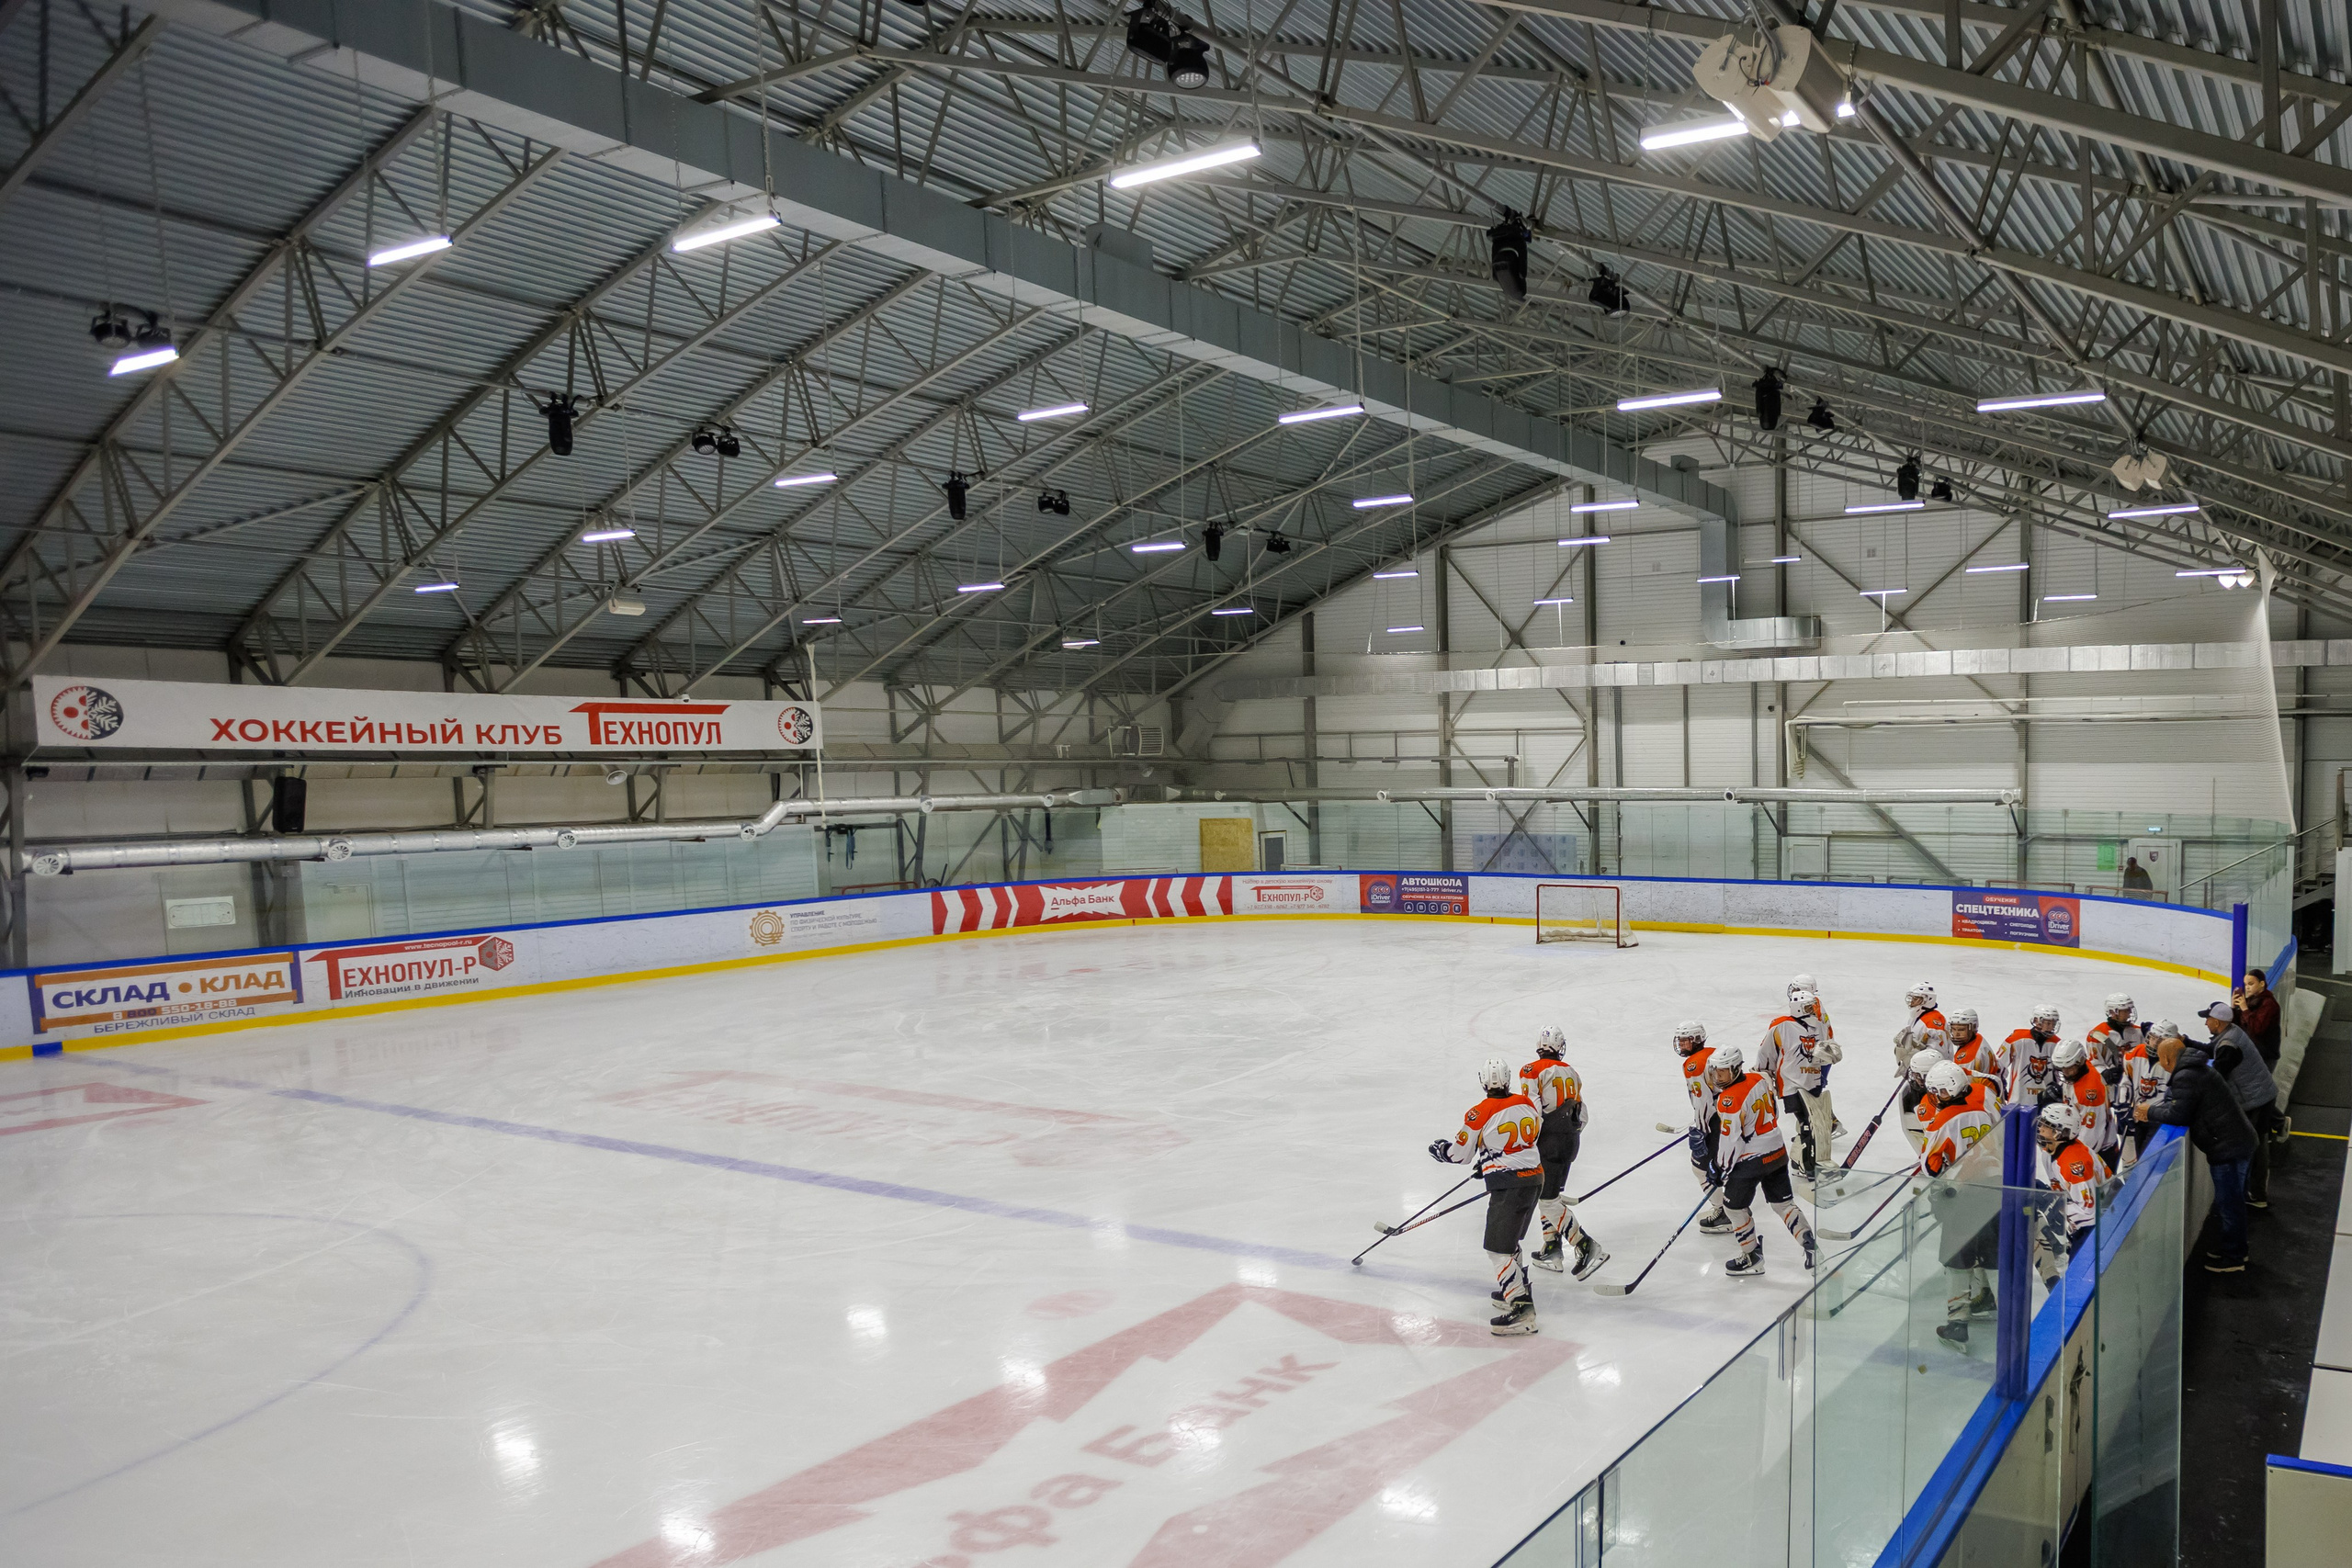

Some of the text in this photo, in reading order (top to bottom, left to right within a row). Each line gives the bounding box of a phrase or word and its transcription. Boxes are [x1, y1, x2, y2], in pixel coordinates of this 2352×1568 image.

[209, 702, 731, 745] ХОККЕЙНЫЙ КЛУБ ТЕХНОПУЛ
[1401, 877, 1463, 886] АВТОШКОЛА
[1250, 886, 1314, 902] ТЕХНОПУЛ-Р
[1050, 895, 1115, 908] Альфа Банк
[790, 910, 825, 919] УПРАВЛЕНИЕ
[1955, 904, 2040, 918] СПЕЦТЕХНИКА
[791, 924, 812, 932] СПОРТУ
[843, 918, 877, 926] МОЛОДЕЖЬЮ
[799, 915, 835, 925] ФИЗИЧЕСКОЙ
[2048, 921, 2069, 930] iDriver
[404, 939, 473, 951] www.tecnopool-r.ru
[304, 935, 489, 1000] ТЕХНОПУЛ-Р
[51, 970, 286, 1009] СКЛАД КЛАД
[345, 985, 411, 998] Инновации
[424, 976, 480, 991] движении
[94, 1007, 256, 1034] БЕРЕЖЛИВЫЙ СКЛАД
[112, 1011, 123, 1021] 8
[127, 1007, 157, 1018] 800
